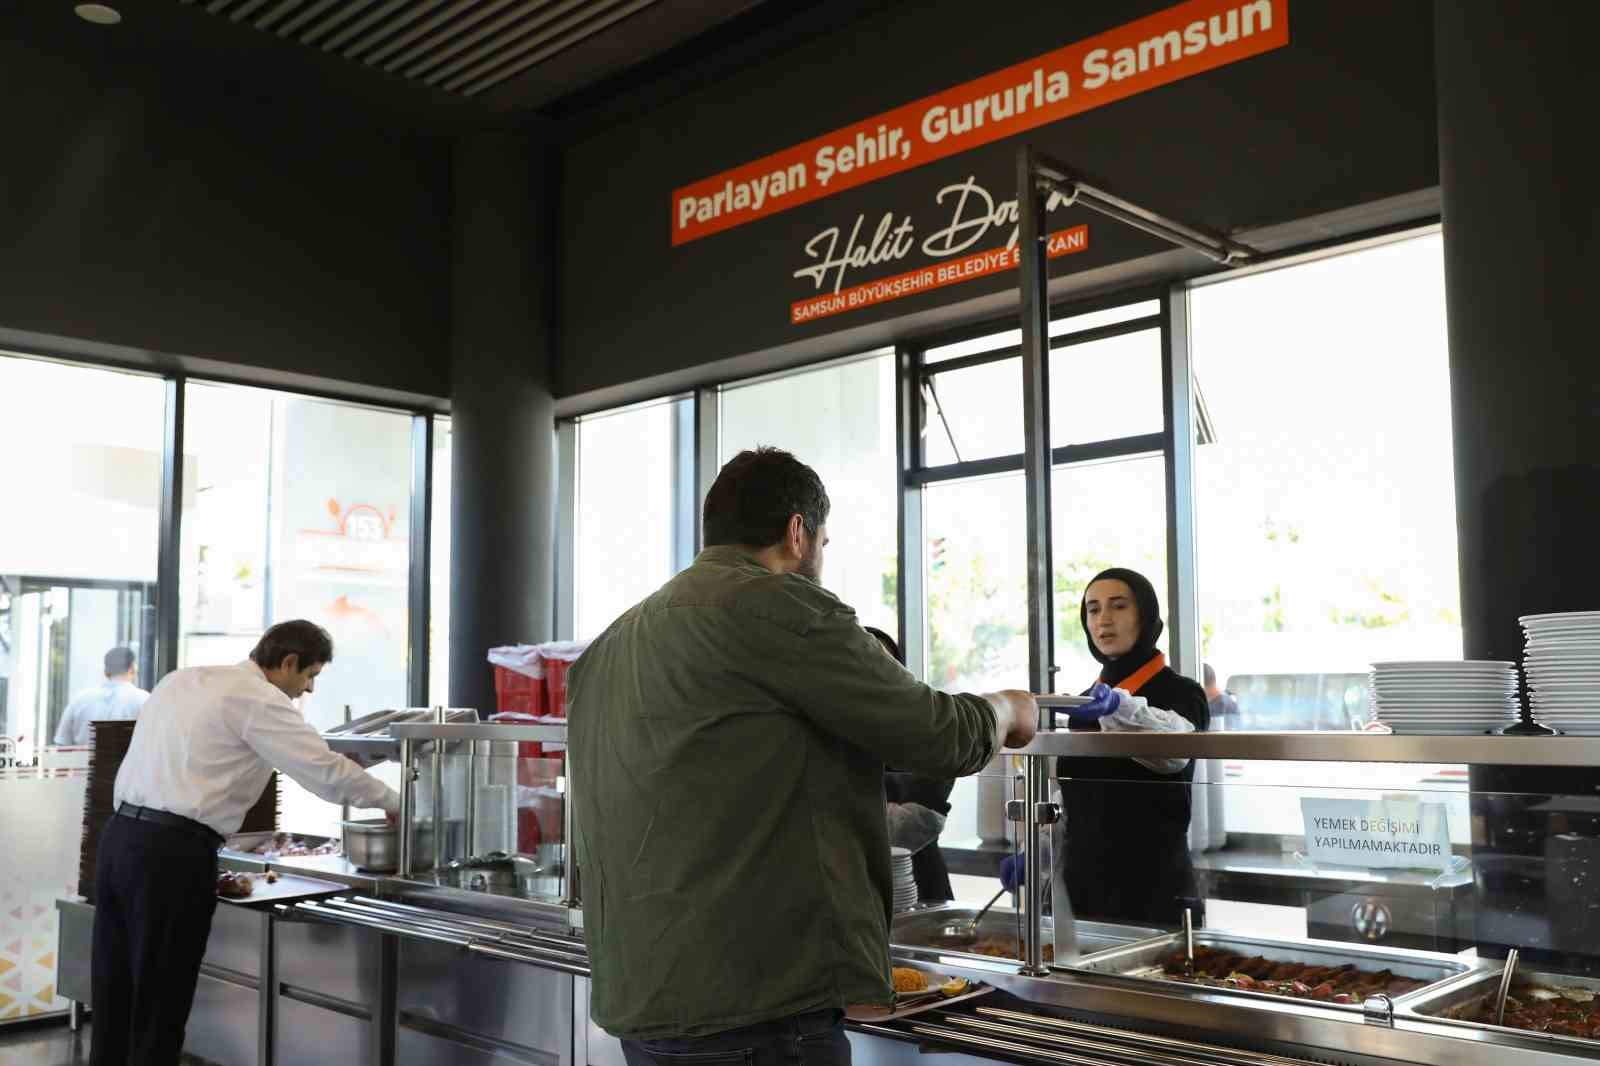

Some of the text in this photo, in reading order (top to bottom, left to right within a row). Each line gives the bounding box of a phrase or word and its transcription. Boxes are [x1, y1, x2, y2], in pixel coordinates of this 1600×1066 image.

[679, 0, 1272, 229] Parlayan Şehir, Gururla Samsun
[793, 211, 914, 295] Halit
[794, 231, 1085, 321] SAMSUN BÜYÜKŞEHİR BELEDİYE BKANI
[1313, 816, 1420, 836] YEMEK DEĞİŞİMİ
[1314, 836, 1441, 856] YAPILMAMAKTADIR
